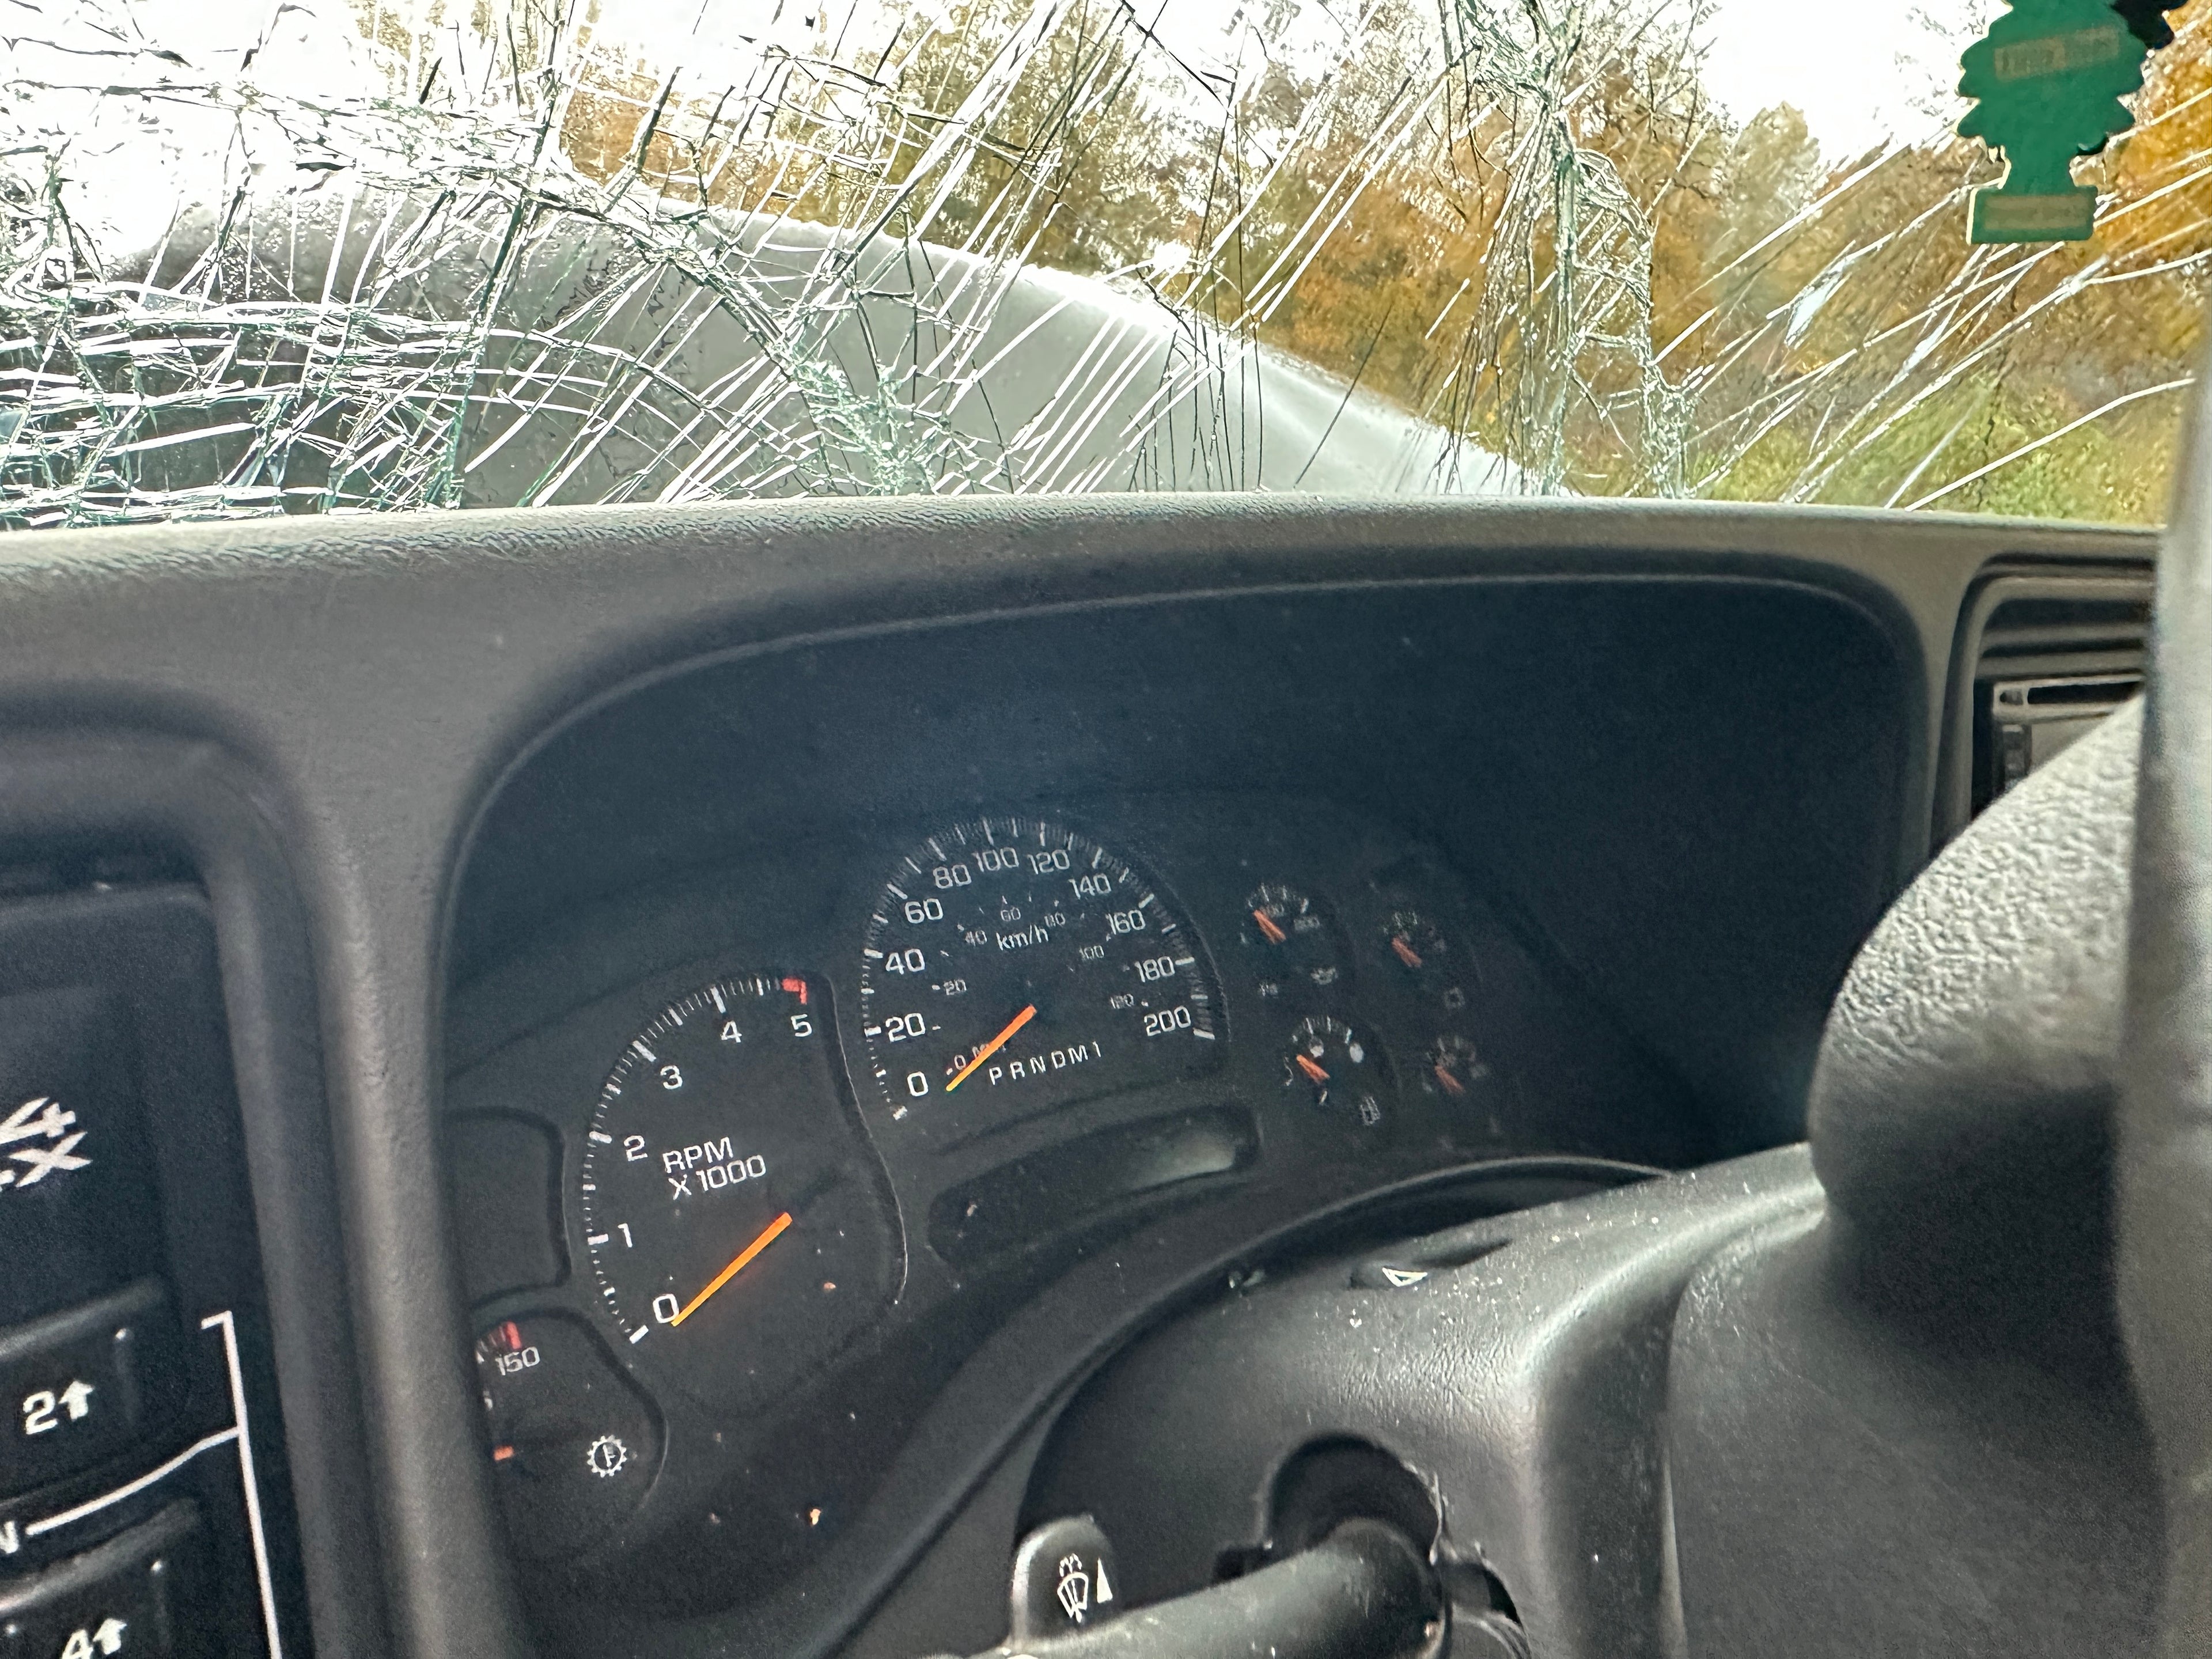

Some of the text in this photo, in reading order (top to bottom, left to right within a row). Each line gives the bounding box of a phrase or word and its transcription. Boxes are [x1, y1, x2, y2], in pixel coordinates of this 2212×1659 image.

[976, 846, 1019, 872] 100
[1028, 849, 1070, 874] 120
[933, 865, 972, 889] 80
[1069, 874, 1112, 900] 140
[904, 897, 944, 924] 60
[1106, 908, 1146, 935] 160
[996, 923, 1049, 951] km/h
[885, 948, 925, 975] 40
[1135, 956, 1175, 983] 180
[721, 1021, 743, 1043] 4
[791, 1014, 812, 1037] 5
[885, 1013, 925, 1041] 20
[1144, 1005, 1191, 1036] 200
[660, 1065, 683, 1090] 3
[907, 1071, 929, 1097] 0
[623, 1135, 648, 1162] 2
[662, 1137, 734, 1173] RPM
[668, 1154, 766, 1200] X 1000
[618, 1223, 632, 1248] 1
[652, 1293, 679, 1324] 0
[495, 1346, 540, 1376] 150
[22, 1391, 58, 1435] 2
